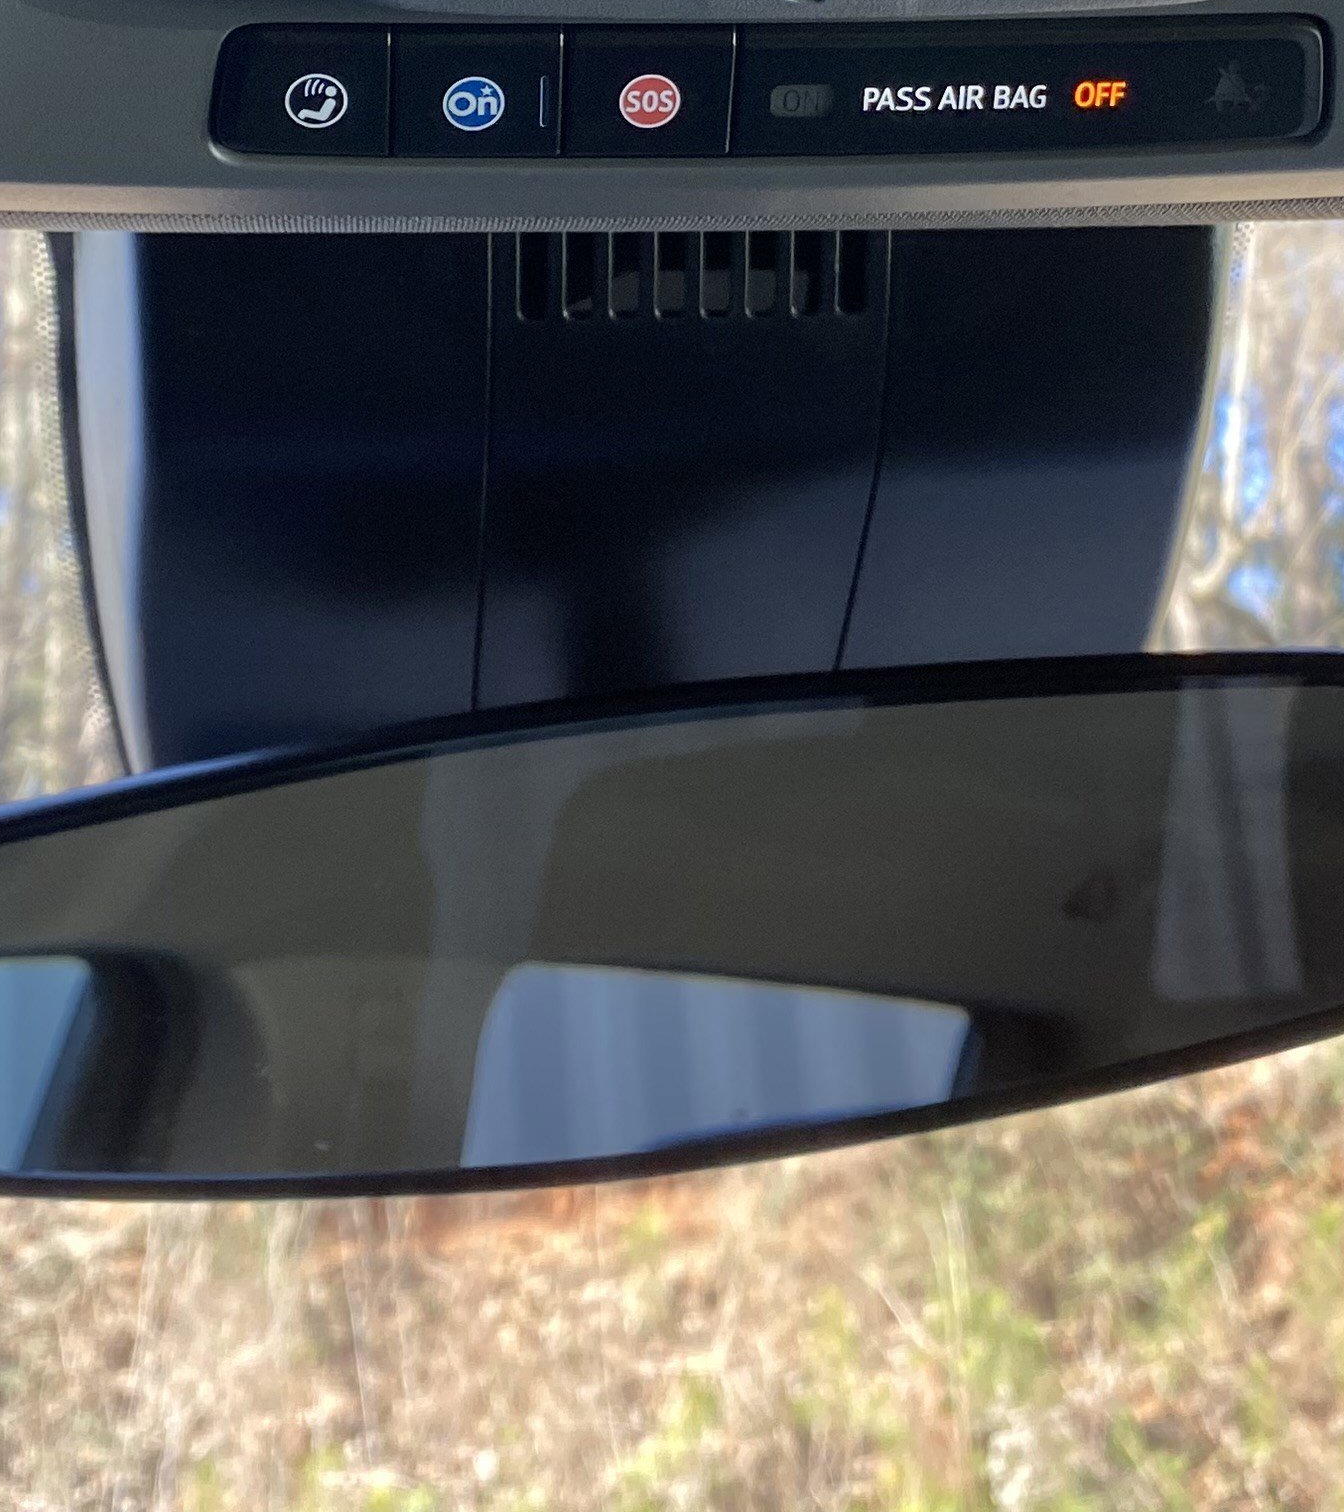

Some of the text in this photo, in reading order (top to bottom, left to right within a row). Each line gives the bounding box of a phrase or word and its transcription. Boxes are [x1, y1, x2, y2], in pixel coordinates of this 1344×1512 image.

[448, 91, 498, 117] On
[626, 89, 675, 113] SOS
[862, 80, 1127, 112] PASS AIR BAG OFF
